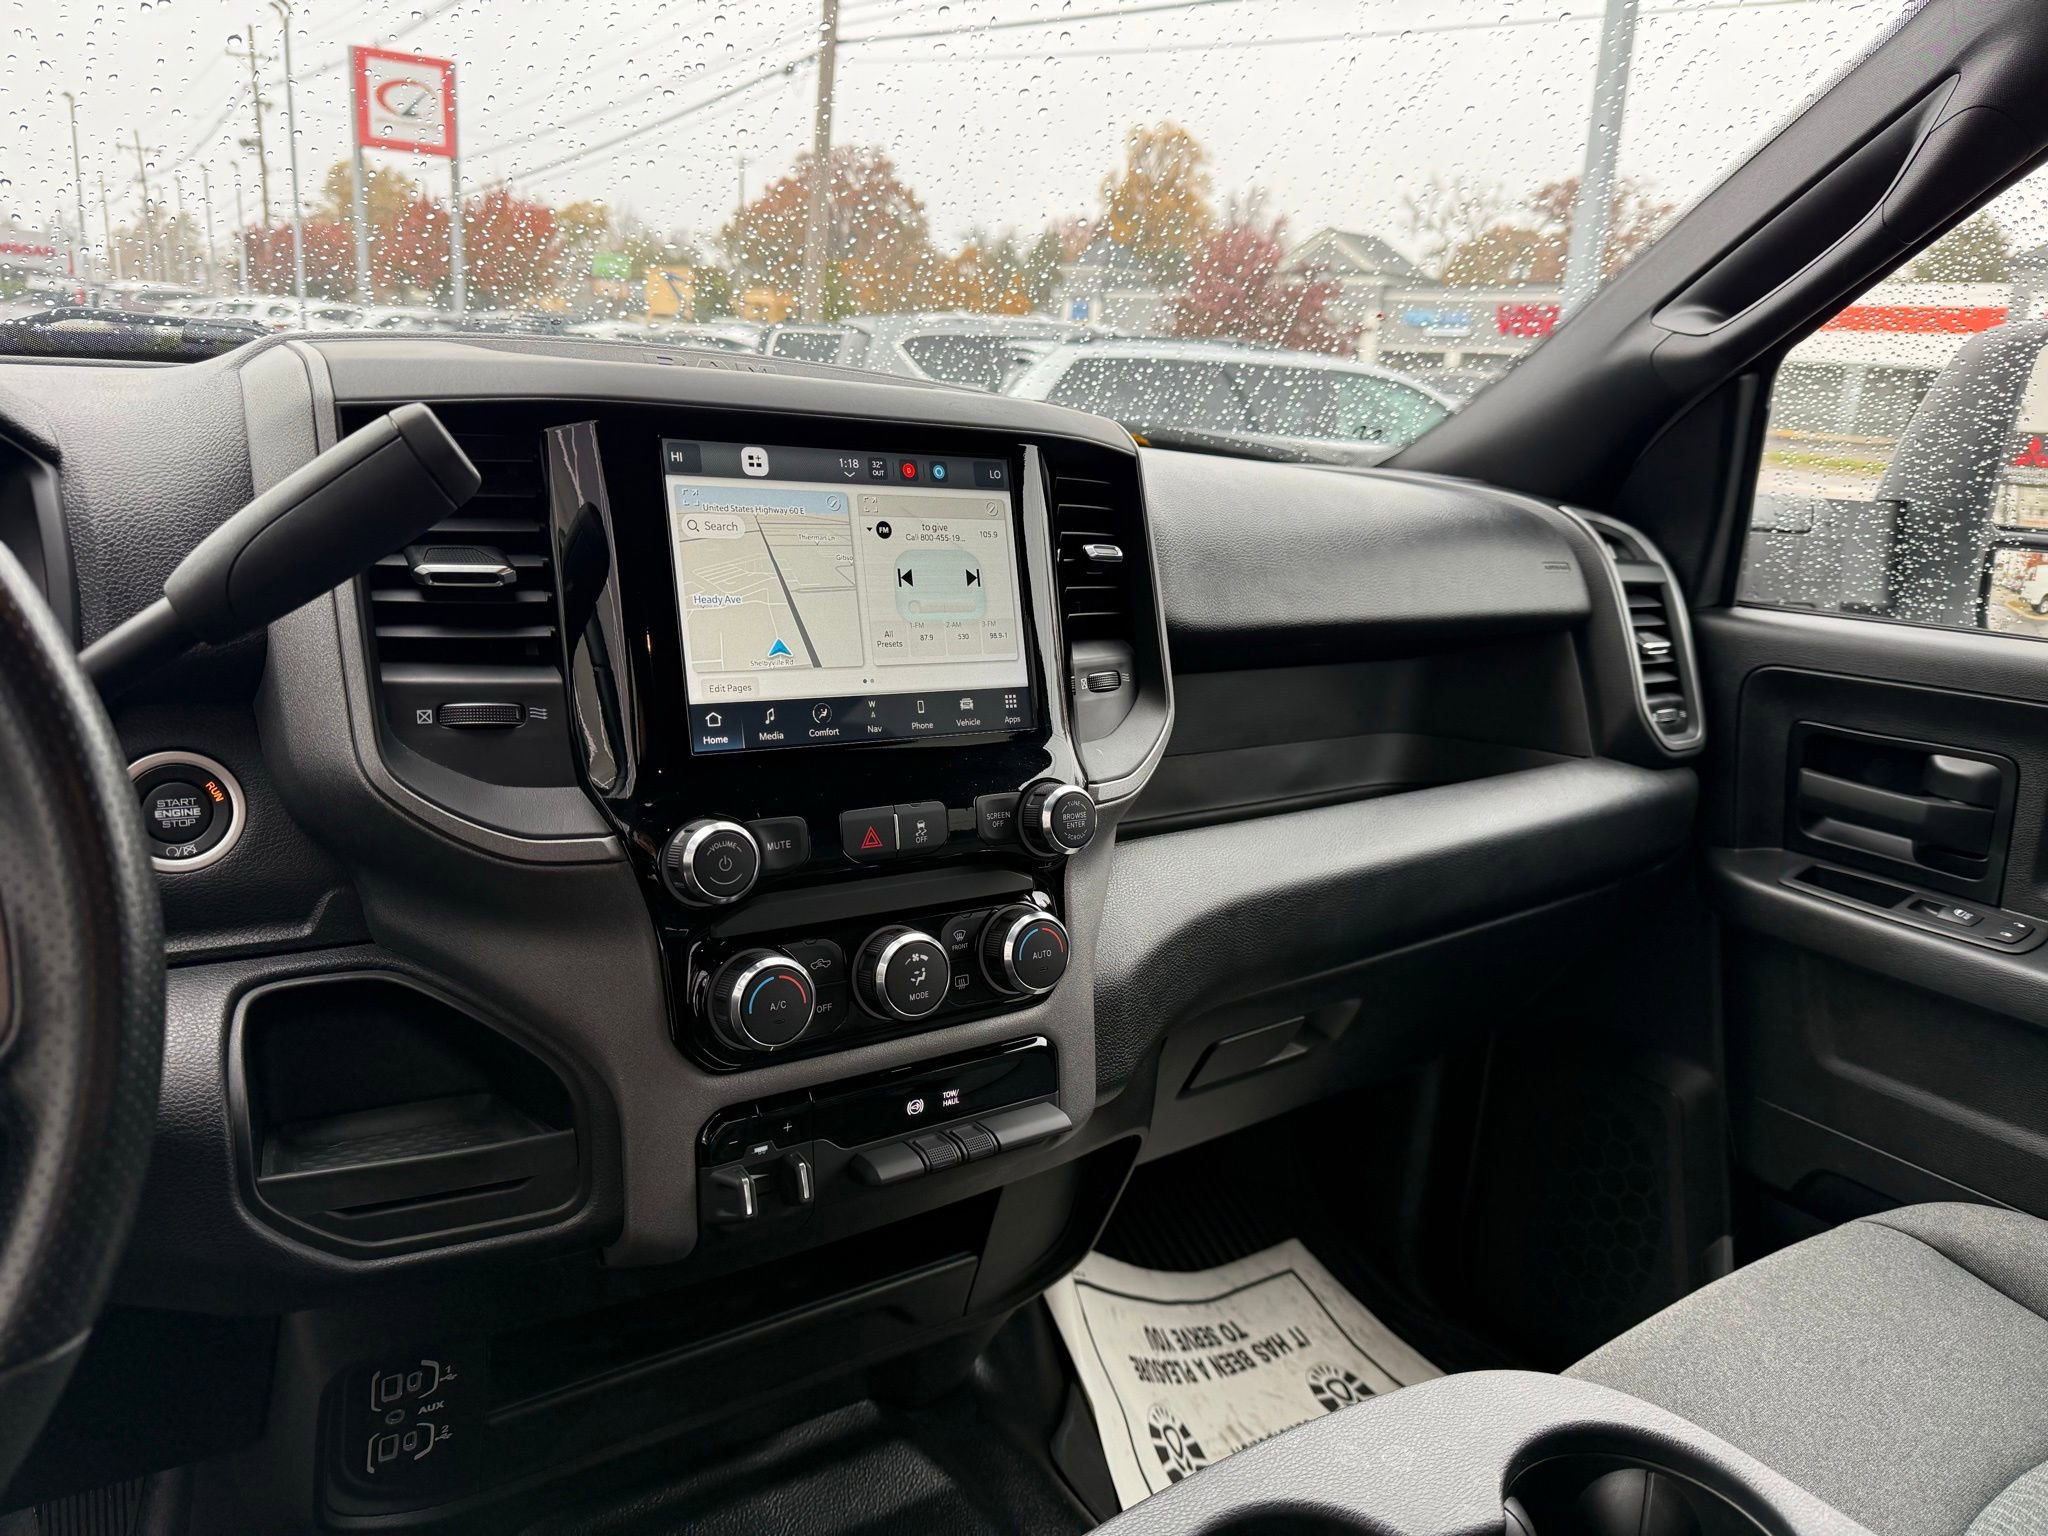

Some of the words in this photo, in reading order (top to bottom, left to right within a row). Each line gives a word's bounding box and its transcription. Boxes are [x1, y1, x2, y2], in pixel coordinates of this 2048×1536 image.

[670, 451, 683, 463] HI
[839, 458, 859, 469] 1:18
[989, 470, 1001, 479] LO
[702, 503, 729, 513] United
[730, 504, 754, 514] States
[755, 506, 788, 517] Highway
[789, 507, 799, 515] 60
[704, 520, 739, 532] Search
[878, 526, 889, 534] FM
[932, 525, 948, 533] give
[905, 533, 919, 541] Call
[979, 530, 998, 539] 105.9
[693, 595, 723, 606] Heady
[724, 595, 742, 604] Ave
[884, 630, 894, 638] All
[876, 640, 903, 648] Presets
[708, 684, 726, 693] Edit
[727, 683, 752, 694] Pages
[956, 718, 981, 727] Vehicle
[1004, 715, 1021, 724] Apps
[867, 725, 883, 733] Nav
[911, 722, 934, 730] Phone
[759, 731, 784, 741] Media
[808, 728, 840, 737] Comfort
[702, 735, 729, 745] Home
[205, 780, 224, 802] RUN
[156, 797, 197, 808] START
[154, 807, 202, 819] ENGINE
[986, 811, 1011, 821] SCREEN
[1062, 811, 1087, 821] BROWSE
[162, 818, 196, 829] STOP
[992, 820, 1005, 828] OFF
[1066, 820, 1086, 830] ENTER
[766, 839, 792, 851] MUTE
[915, 835, 928, 844] OFF
[709, 840, 738, 852] VOLUME
[951, 942, 968, 951] FRONT
[1032, 949, 1052, 960] AUTO
[909, 990, 929, 1002] MODE
[769, 999, 787, 1012] A/C
[816, 1002, 833, 1014] OFF
[942, 1089, 960, 1098] TOW/
[942, 1097, 960, 1107] HAUL
[1218, 1320, 1249, 1343] TO
[1287, 1325, 1311, 1349] IT
[1144, 1325, 1177, 1352] YOU
[1169, 1325, 1223, 1351] SERVE
[1251, 1333, 1293, 1363] HAS
[1192, 1356, 1211, 1381] A
[1207, 1349, 1257, 1378] BEEN
[1128, 1354, 1198, 1385] PLEASURE
[417, 1400, 445, 1415] AUX
